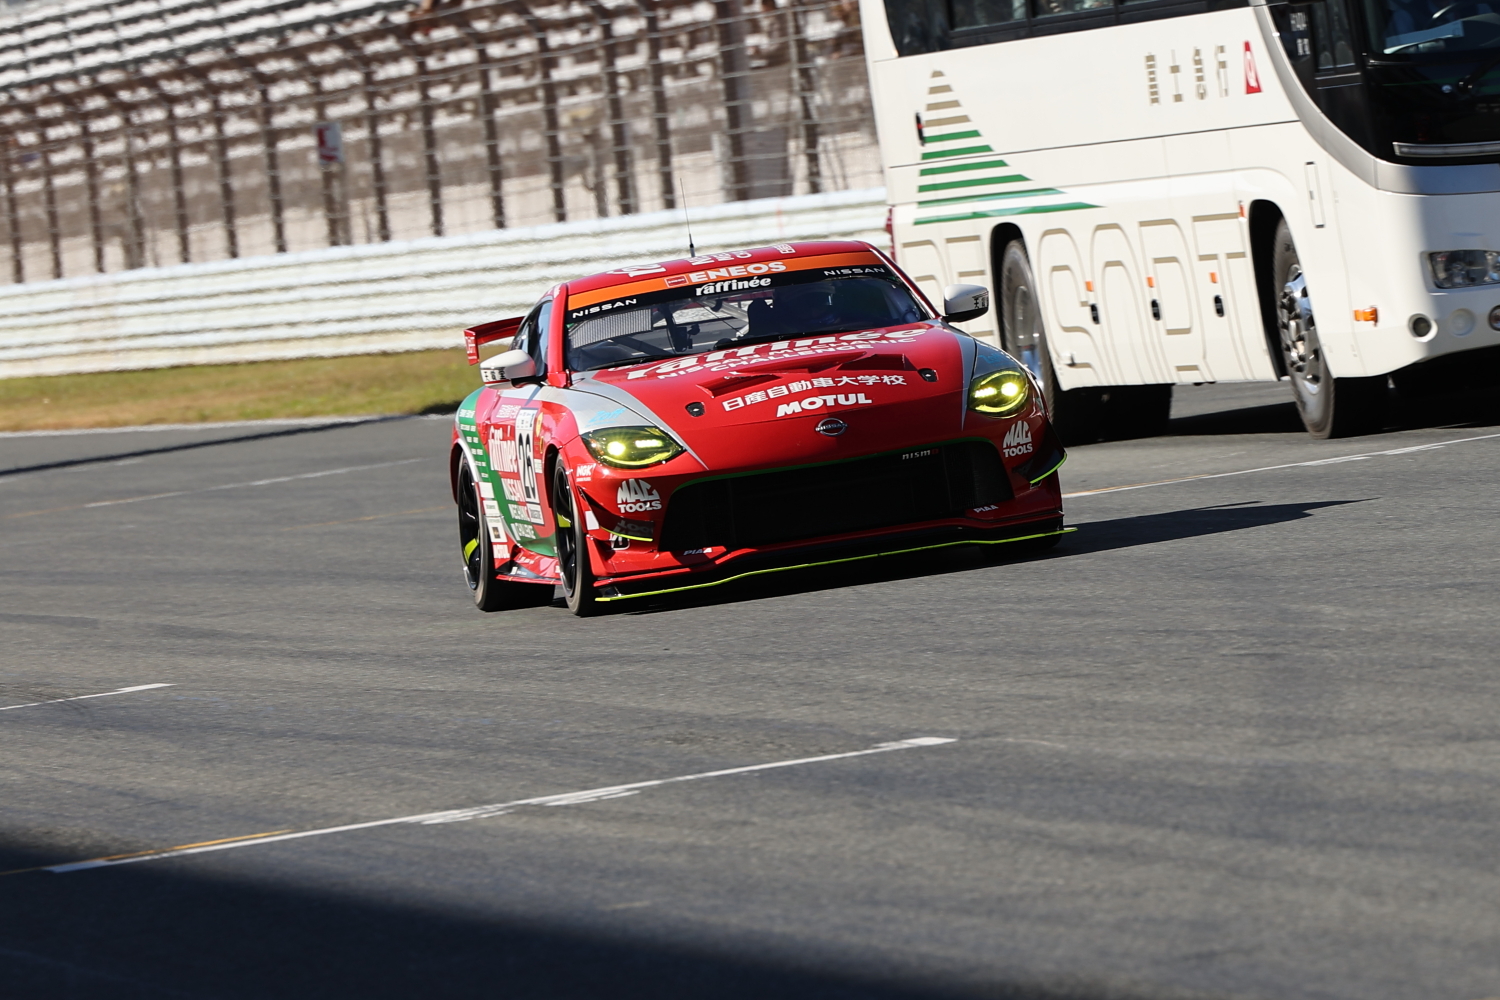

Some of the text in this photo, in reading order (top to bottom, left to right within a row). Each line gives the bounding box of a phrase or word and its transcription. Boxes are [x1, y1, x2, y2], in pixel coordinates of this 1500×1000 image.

[689, 261, 787, 283] ENEOS
[823, 267, 885, 276] NISSAN
[696, 276, 771, 296] raffinée
[572, 299, 637, 318] NISSAN
[627, 329, 927, 380] raffinée
[657, 336, 917, 380] NISSAN MECHANIC
[711, 344, 874, 371] CHALLENGE
[722, 375, 907, 412] 日産自動車大学校
[776, 393, 873, 418] MOTUL
[1003, 420, 1032, 448] MAC
[902, 449, 939, 460] nismo
[1003, 443, 1033, 457] TOOLS
[518, 433, 536, 499] 26
[576, 463, 597, 477] NGK
[617, 478, 660, 503] MAC
[617, 500, 662, 513] TOOLS
[973, 505, 999, 513] PIAA
[683, 548, 712, 556] PIAA
